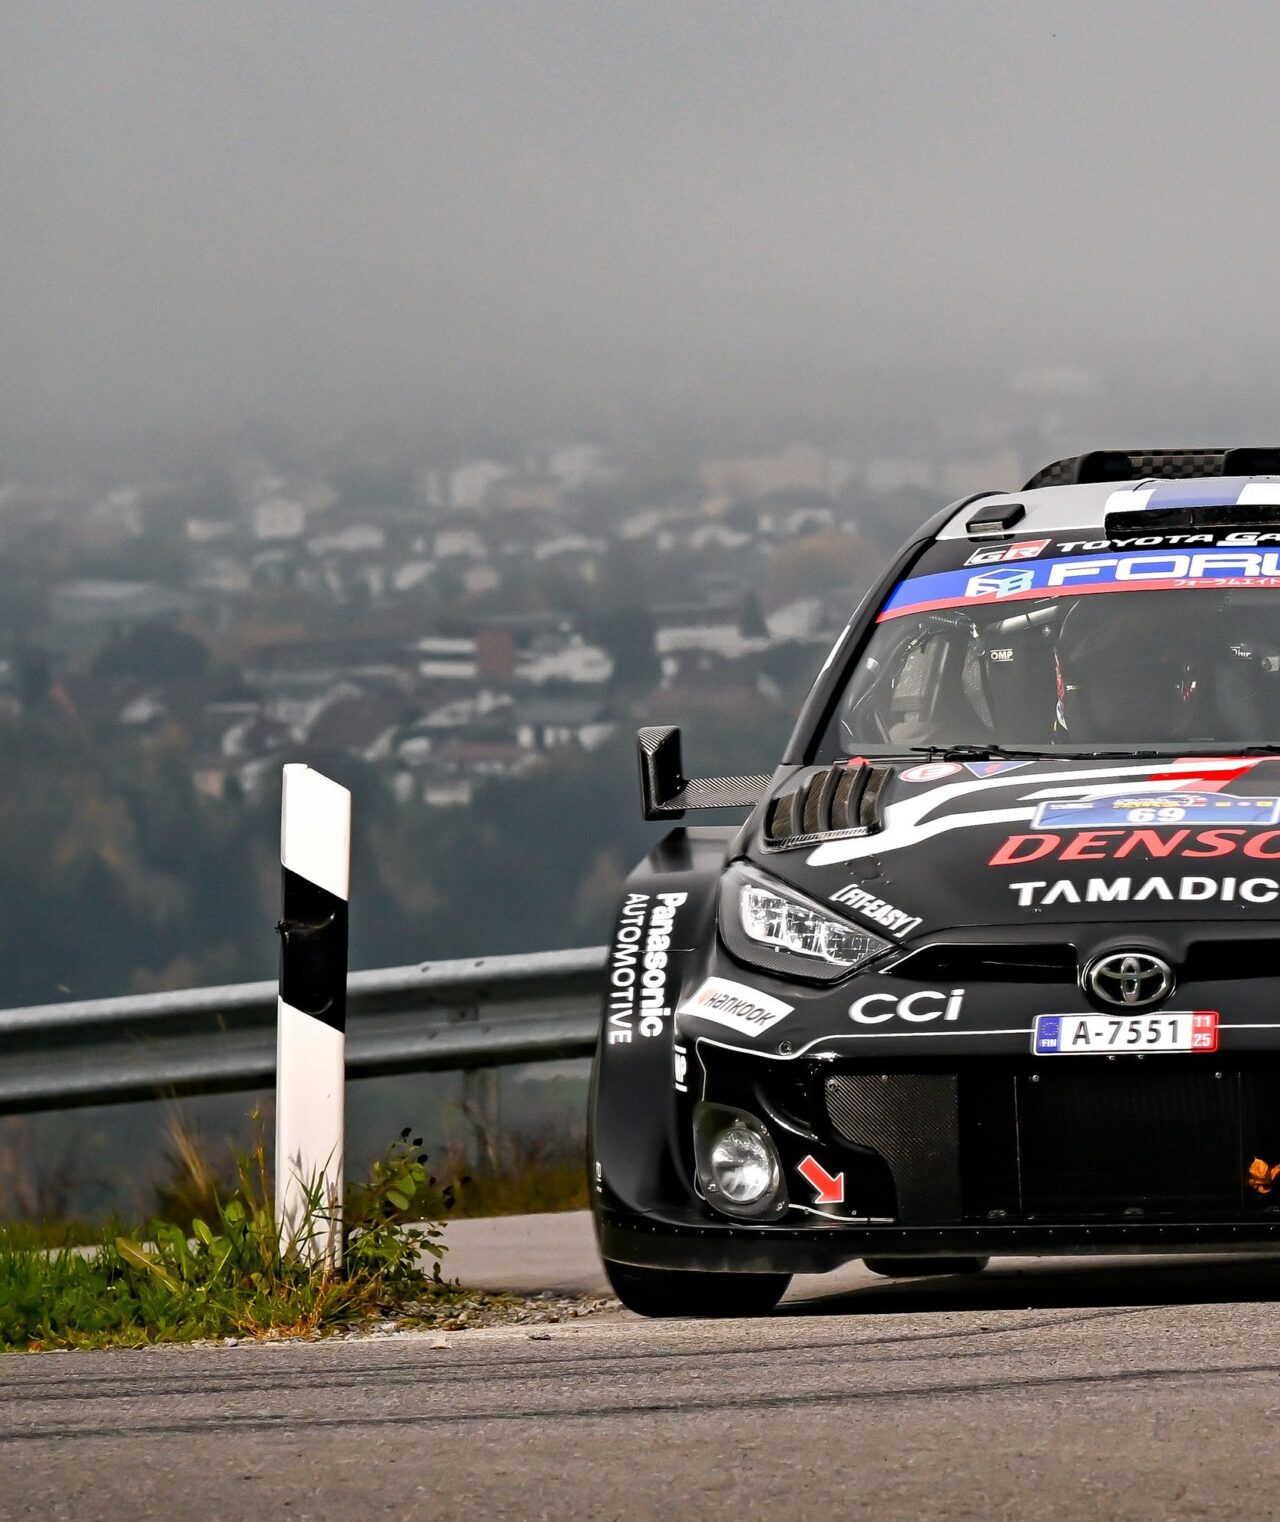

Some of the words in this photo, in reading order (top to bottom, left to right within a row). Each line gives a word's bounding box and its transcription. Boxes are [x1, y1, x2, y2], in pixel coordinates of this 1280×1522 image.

[1057, 534, 1213, 552] TOYOTA
[970, 543, 1043, 564] GR
[990, 649, 1014, 661] OMP
[1126, 807, 1187, 822] 69
[1009, 876, 1280, 907] TAMADIC
[609, 893, 651, 1045] AUTOMOTIVE
[639, 892, 688, 1038] Panasonic
[1193, 1016, 1210, 1027] 11
[1071, 1019, 1179, 1045] A-7551
[1192, 1033, 1211, 1047] 25
[1040, 1039, 1057, 1048] FIN
